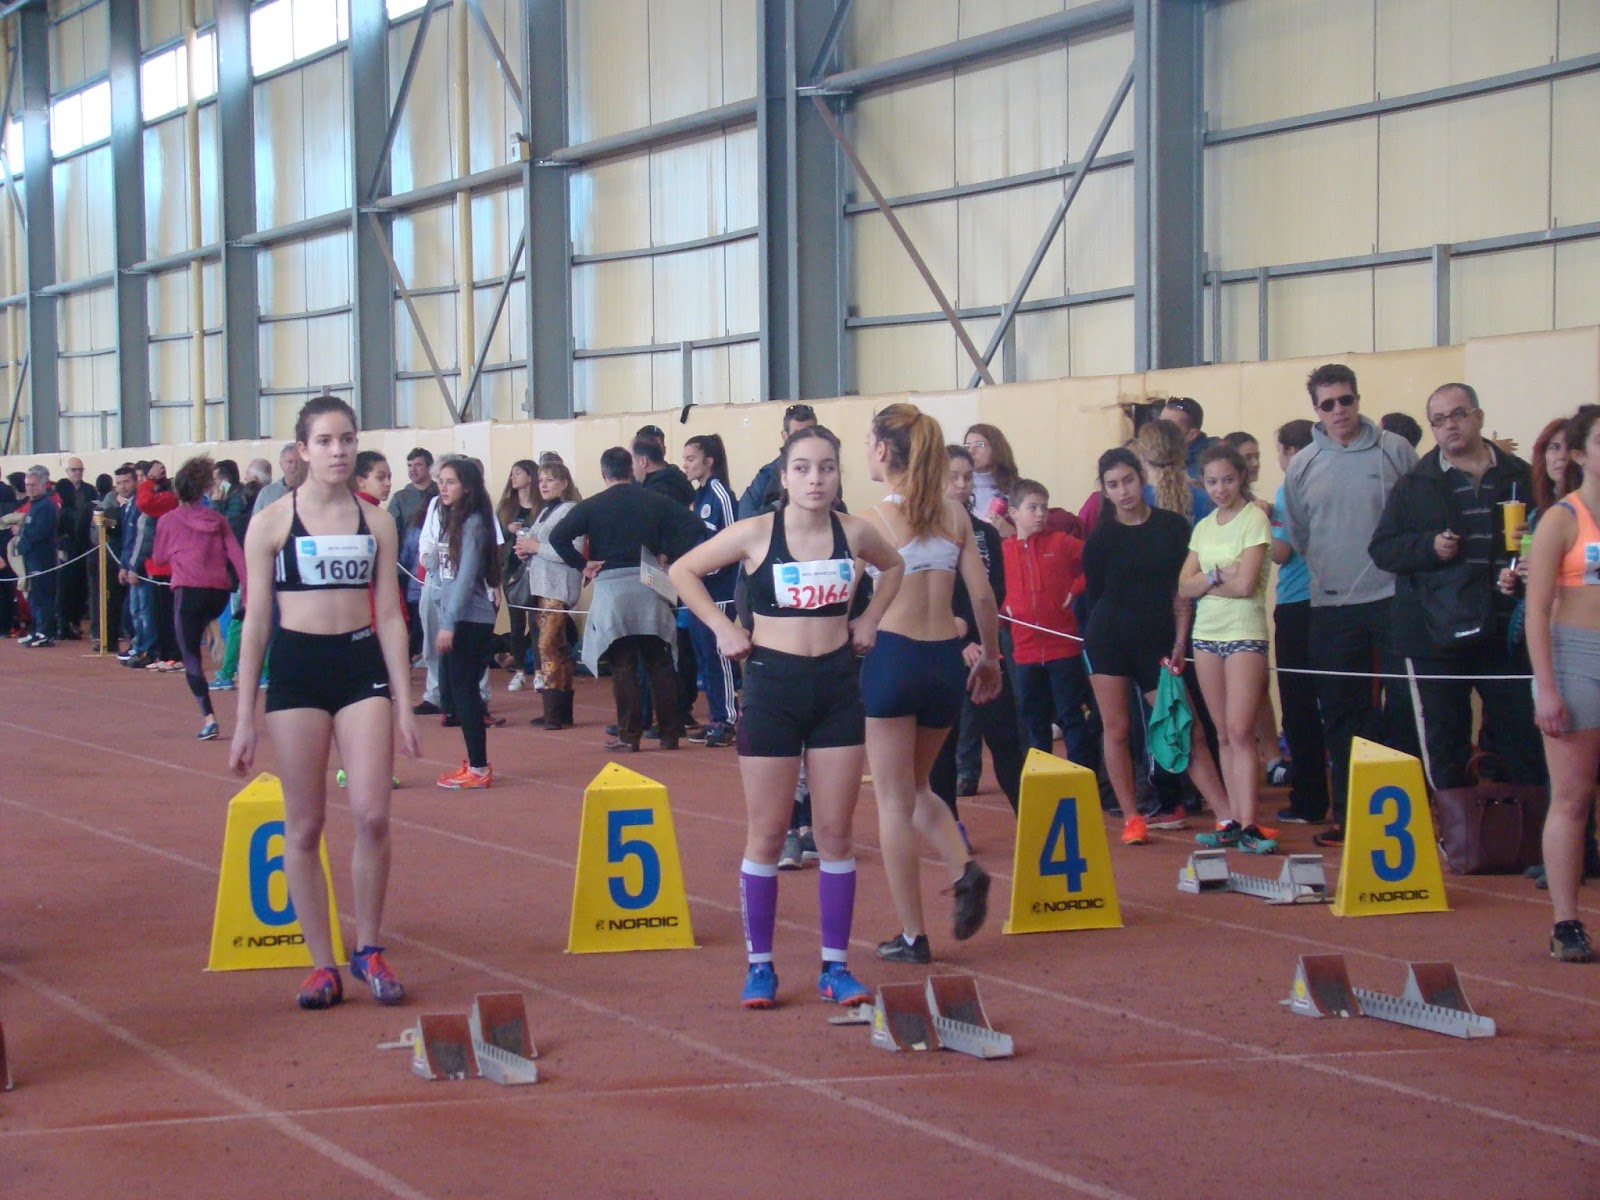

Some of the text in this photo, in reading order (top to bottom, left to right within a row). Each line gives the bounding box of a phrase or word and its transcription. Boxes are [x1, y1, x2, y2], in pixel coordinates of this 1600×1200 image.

[315, 560, 369, 580] 1602
[1369, 785, 1416, 882] 3
[1039, 797, 1088, 893] 4
[607, 808, 661, 910] 5
[249, 820, 298, 926] 6
[1044, 898, 1104, 912] NORDIC
[1370, 889, 1429, 903] NORDIC
[608, 916, 678, 931] NORDIC
[247, 934, 305, 947] NORD
